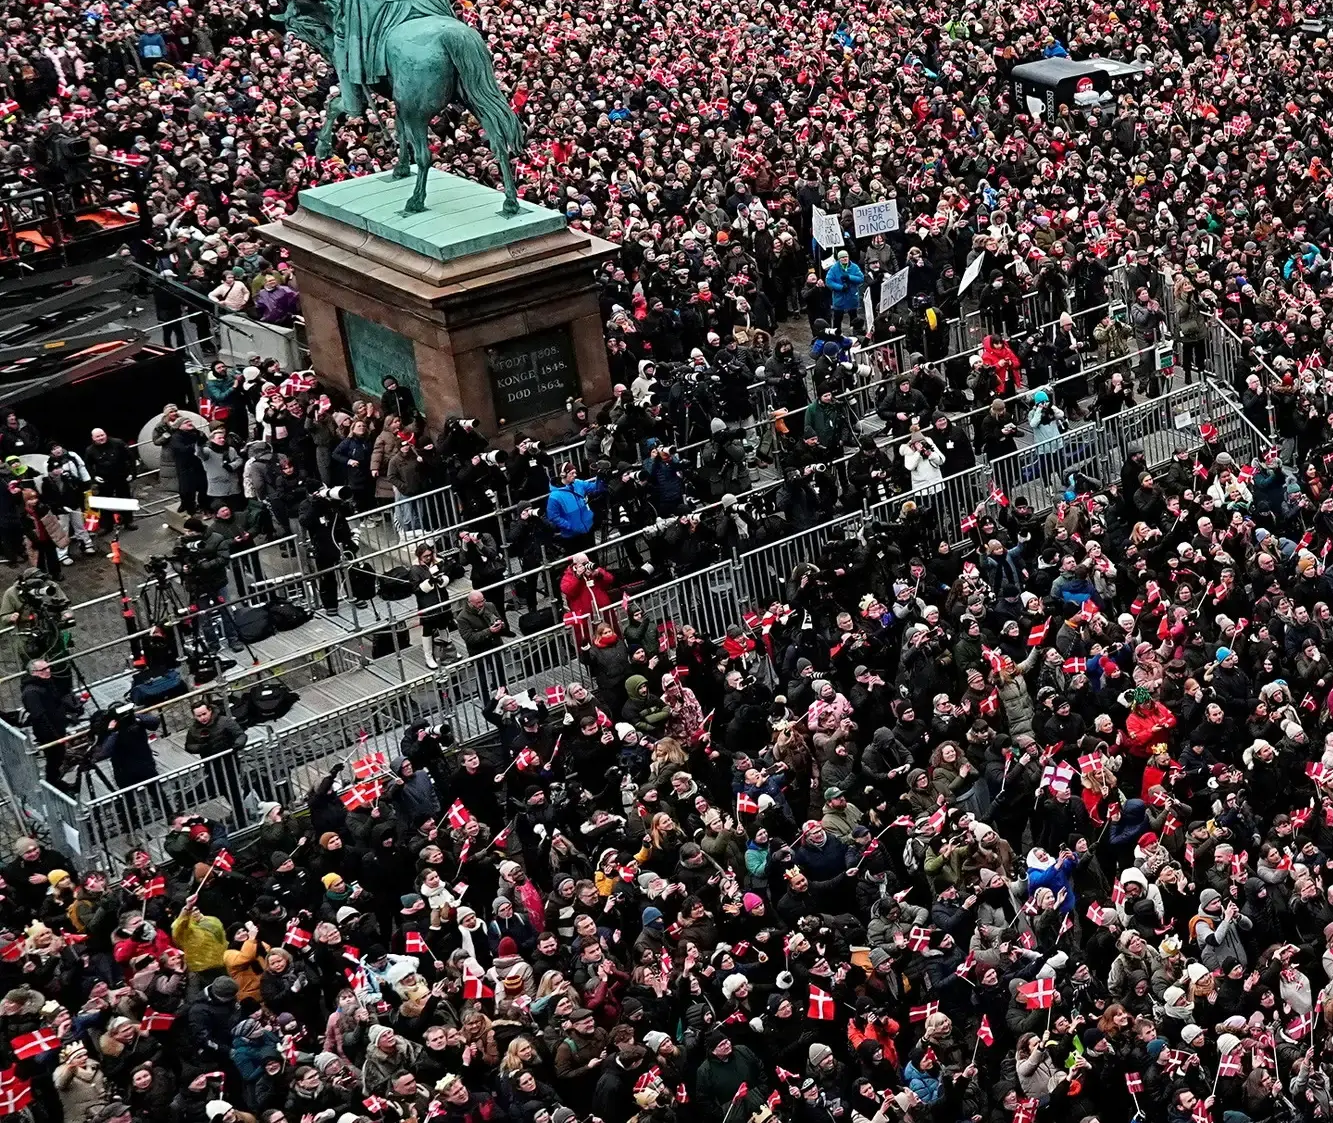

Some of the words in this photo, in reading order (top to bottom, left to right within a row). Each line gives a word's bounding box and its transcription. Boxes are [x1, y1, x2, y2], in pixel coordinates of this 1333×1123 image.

[857, 203, 890, 218] JUSTICE
[868, 213, 883, 222] FOR
[859, 218, 895, 235] PINGO
[497, 370, 536, 389] KONGE
[541, 361, 568, 375] 1848.
[508, 388, 531, 402] DØD
